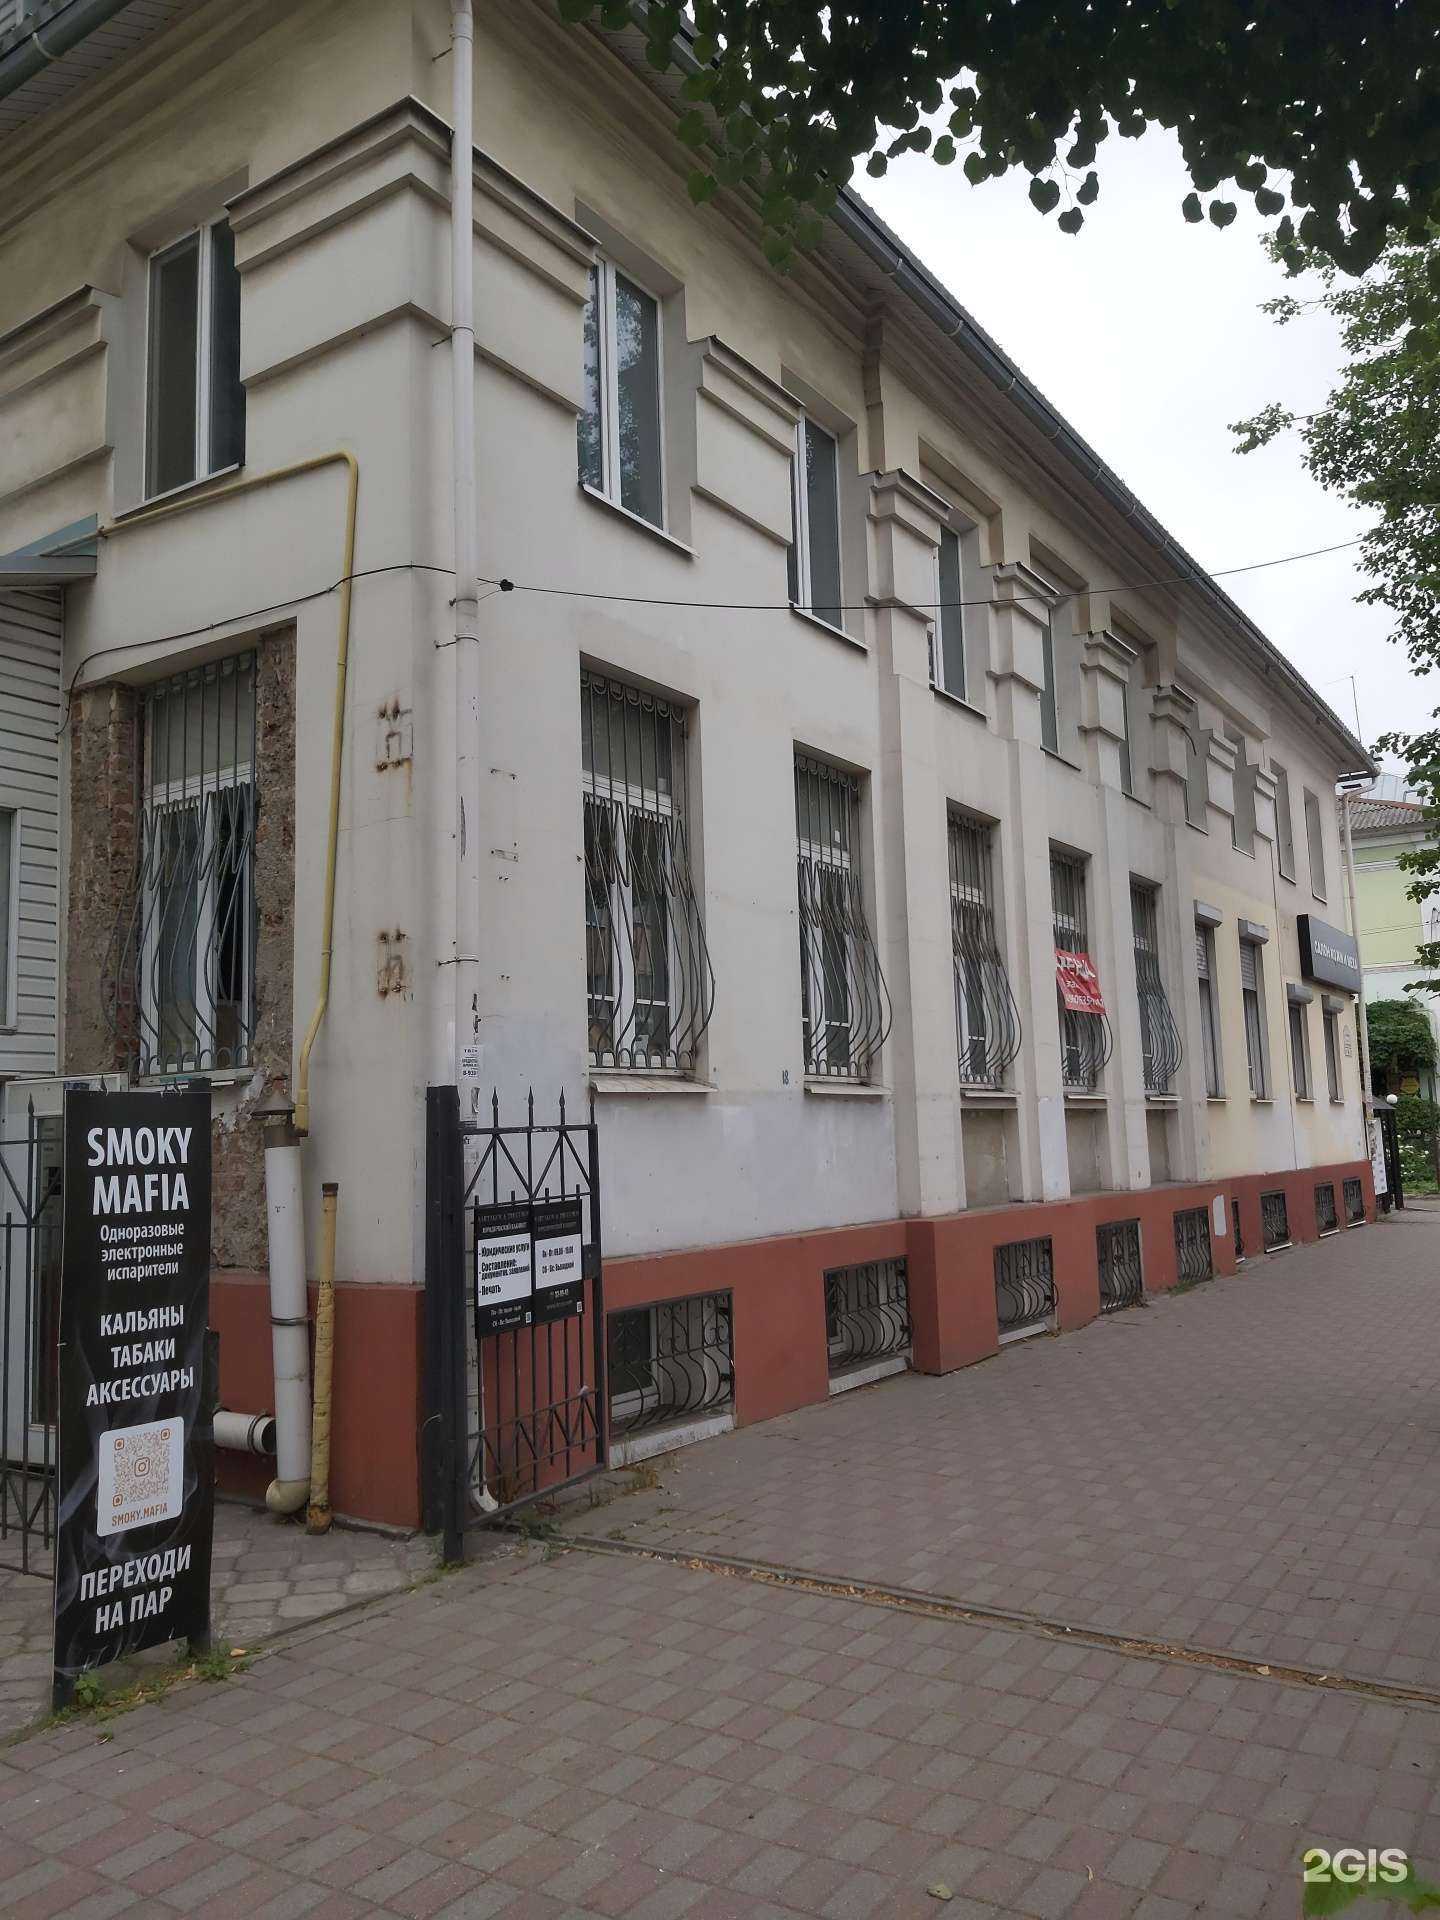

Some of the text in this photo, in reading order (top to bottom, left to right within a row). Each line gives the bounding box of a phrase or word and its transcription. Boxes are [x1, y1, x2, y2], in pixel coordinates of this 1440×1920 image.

[87, 1127, 192, 1167] SMOKY
[92, 1173, 190, 1215] MAFIA
[100, 1222, 185, 1243] Одноразовые
[101, 1242, 184, 1262] электронные
[107, 1262, 179, 1282] испарители
[100, 1305, 184, 1336] КАЛЬЯНЫ
[111, 1338, 175, 1368] ТАБАКИ
[86, 1366, 194, 1407] АКСЕССУАРЫ
[112, 1503, 167, 1526] SMOKY.MAFIA
[80, 1544, 191, 1601] ПЕРЕХОДИ
[95, 1586, 173, 1634] НА ПАР
